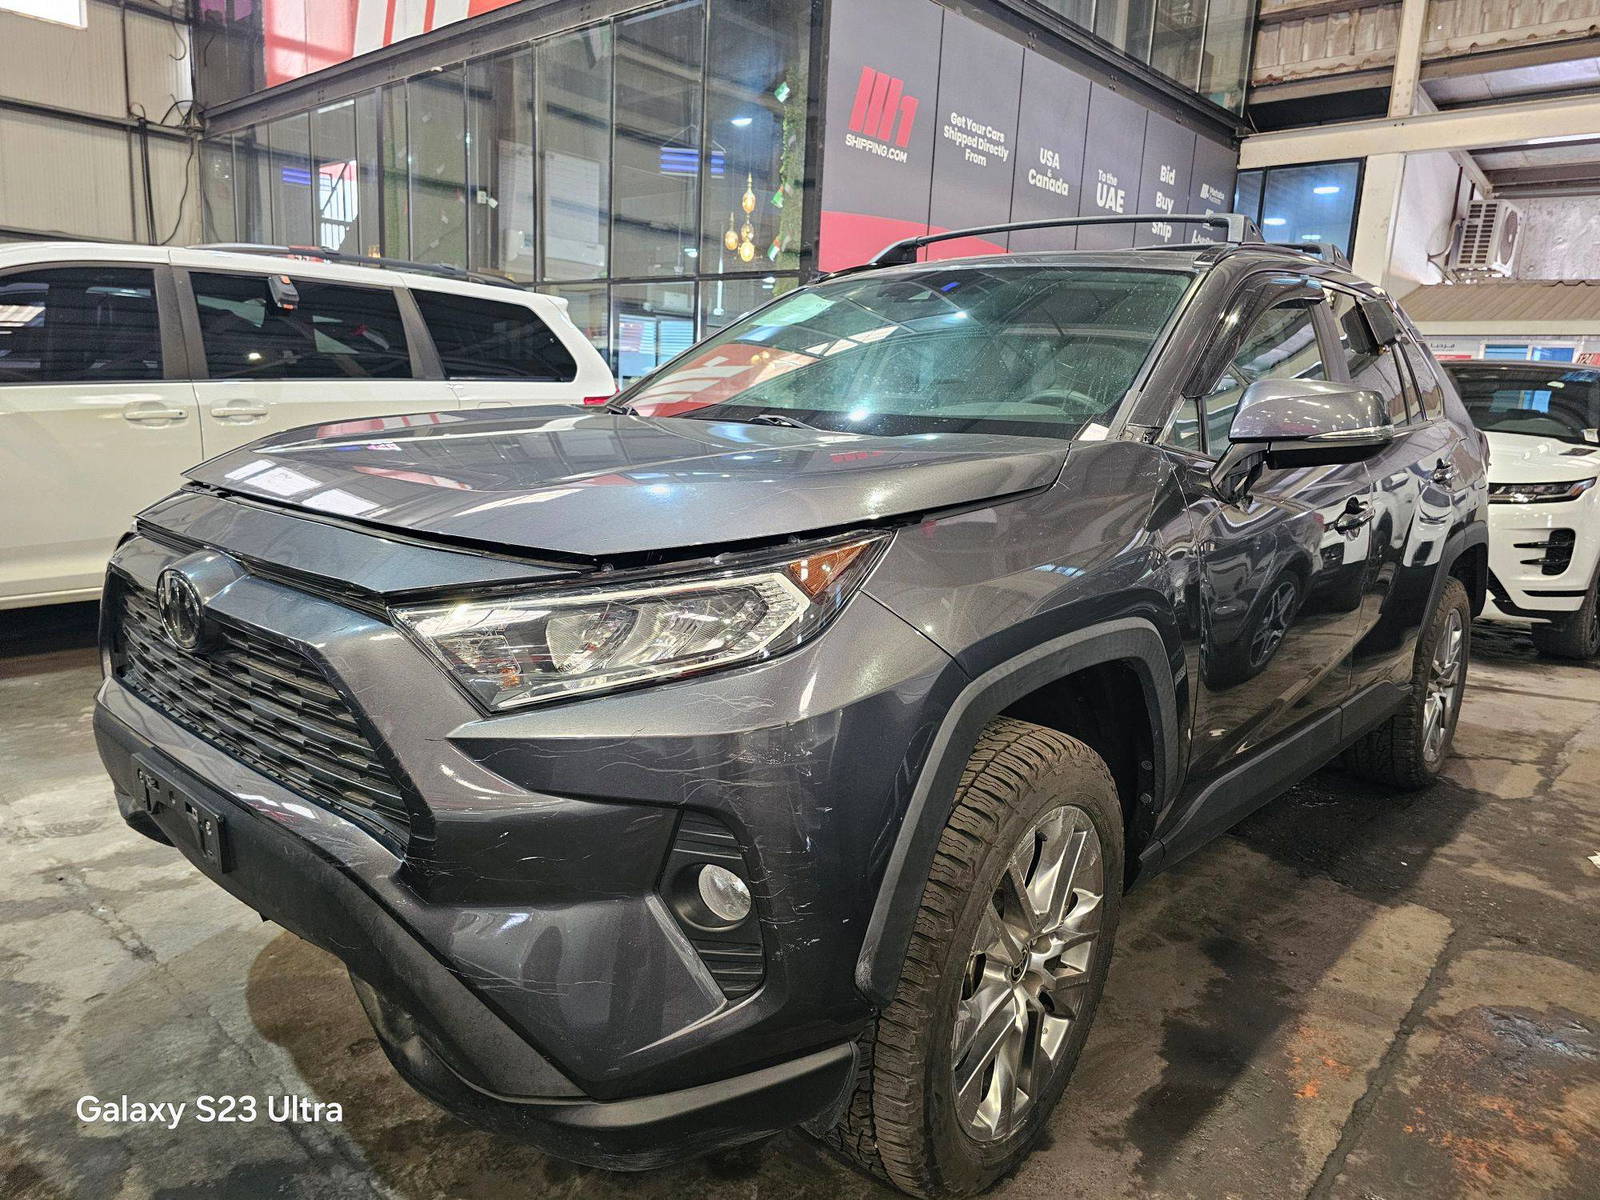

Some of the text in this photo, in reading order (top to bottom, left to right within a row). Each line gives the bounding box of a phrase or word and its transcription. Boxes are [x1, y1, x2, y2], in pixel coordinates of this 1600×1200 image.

[950, 111, 1005, 143] Get Your Cars
[845, 133, 909, 164] SHIPPING.COM
[943, 125, 1009, 163] Shipped Directly
[965, 149, 987, 167] From
[1039, 147, 1060, 170] USA
[1028, 168, 1069, 196] Canada
[1098, 169, 1118, 186] To the
[1160, 164, 1176, 186] Bid
[1096, 182, 1125, 214] UAE
[1155, 191, 1174, 215] Buy
